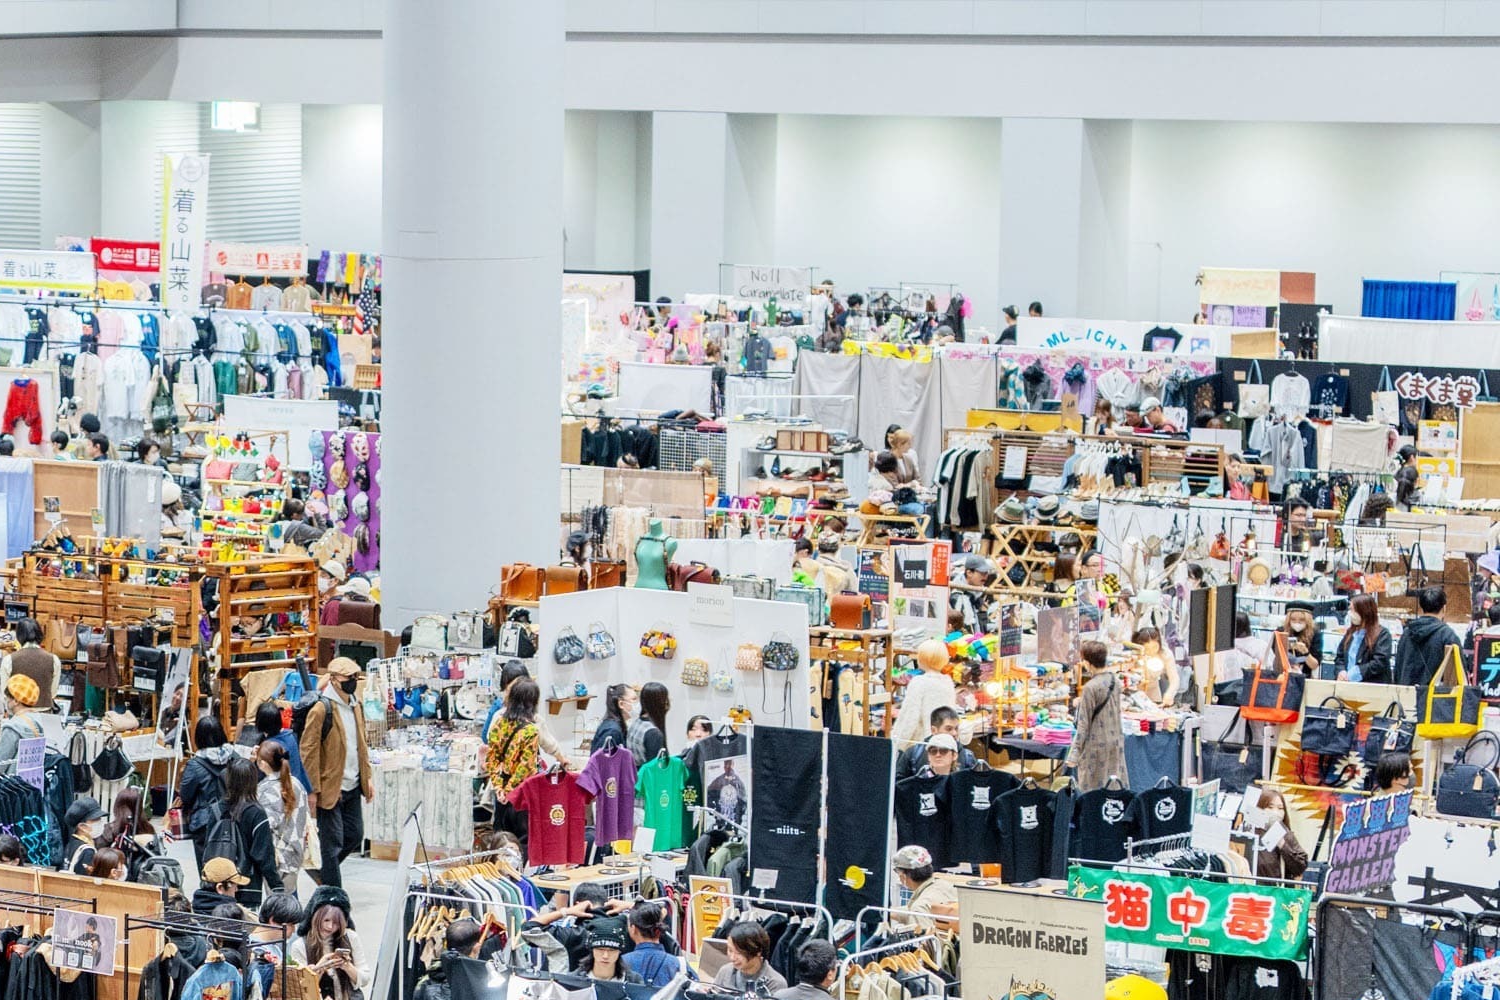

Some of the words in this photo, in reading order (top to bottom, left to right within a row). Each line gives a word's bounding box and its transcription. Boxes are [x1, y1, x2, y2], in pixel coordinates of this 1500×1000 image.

[169, 188, 196, 303] 着る山菜。
[3, 260, 62, 279] 着る山菜。
[1395, 371, 1479, 408] くまくま堂
[696, 596, 725, 608] morico
[1105, 881, 1274, 942] 猫中毒
[973, 922, 1031, 949] DRAGON
